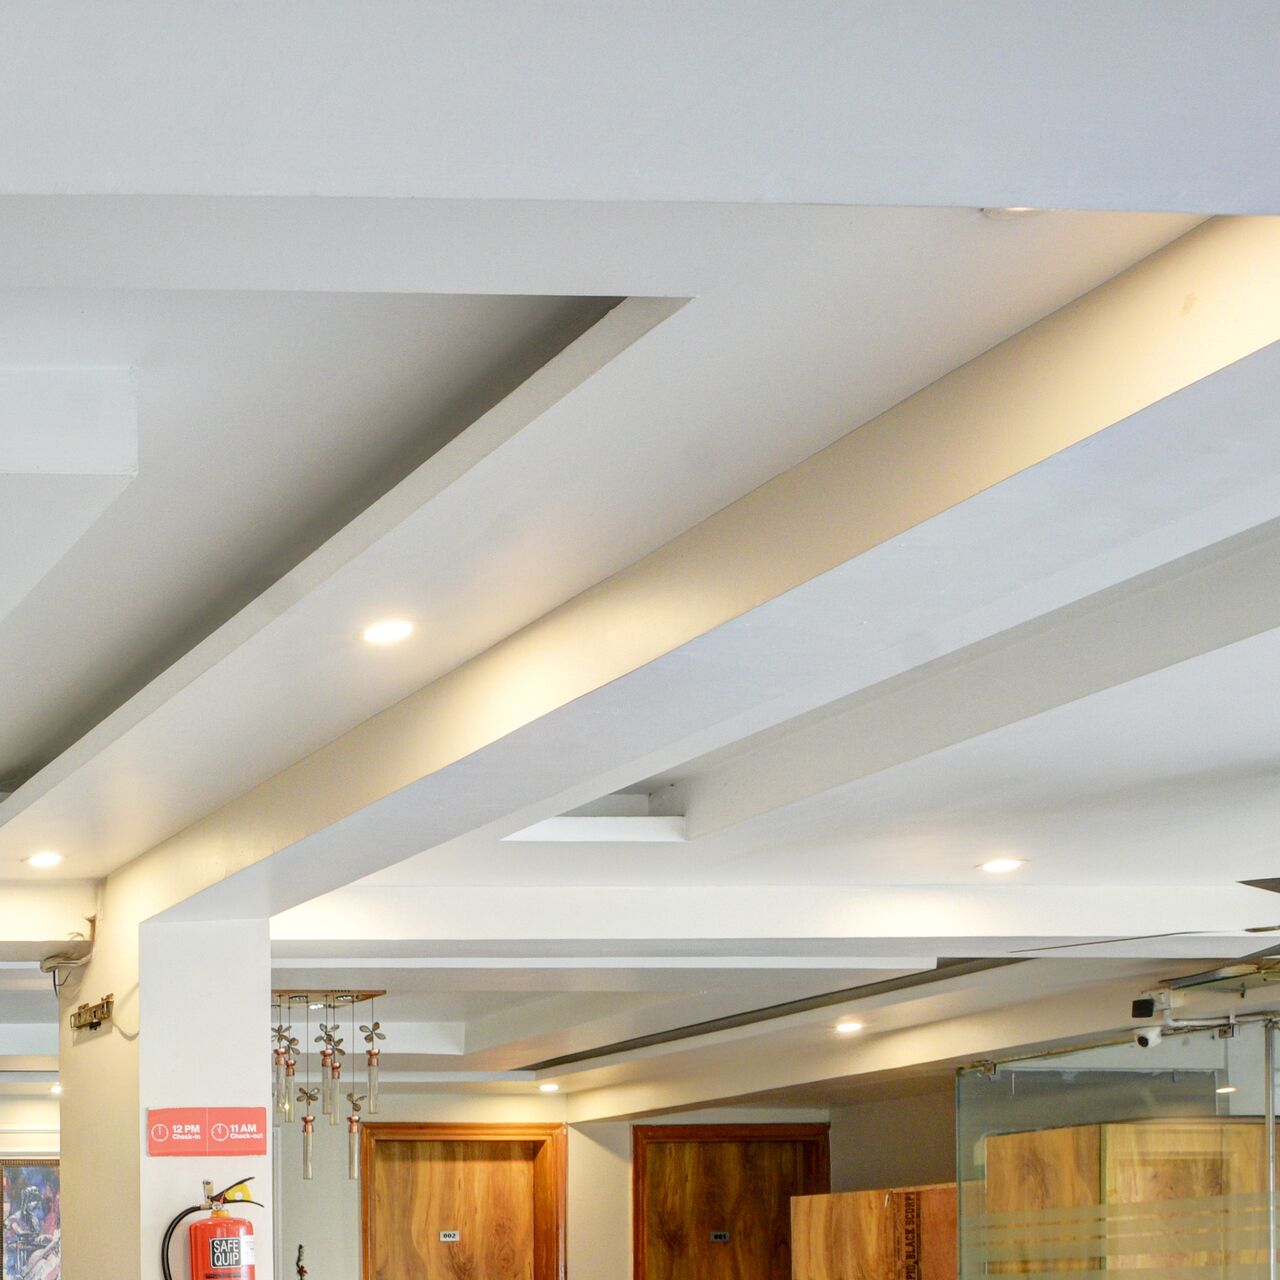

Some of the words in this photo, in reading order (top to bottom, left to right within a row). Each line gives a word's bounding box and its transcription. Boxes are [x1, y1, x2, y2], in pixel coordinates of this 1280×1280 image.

[172, 1125, 183, 1133] 12
[185, 1125, 200, 1133] PM
[230, 1124, 239, 1132] 11
[240, 1124, 257, 1132] AM
[213, 1240, 240, 1253] SAFE
[905, 1228, 916, 1260] BLACK
[214, 1252, 240, 1266] QUIP
